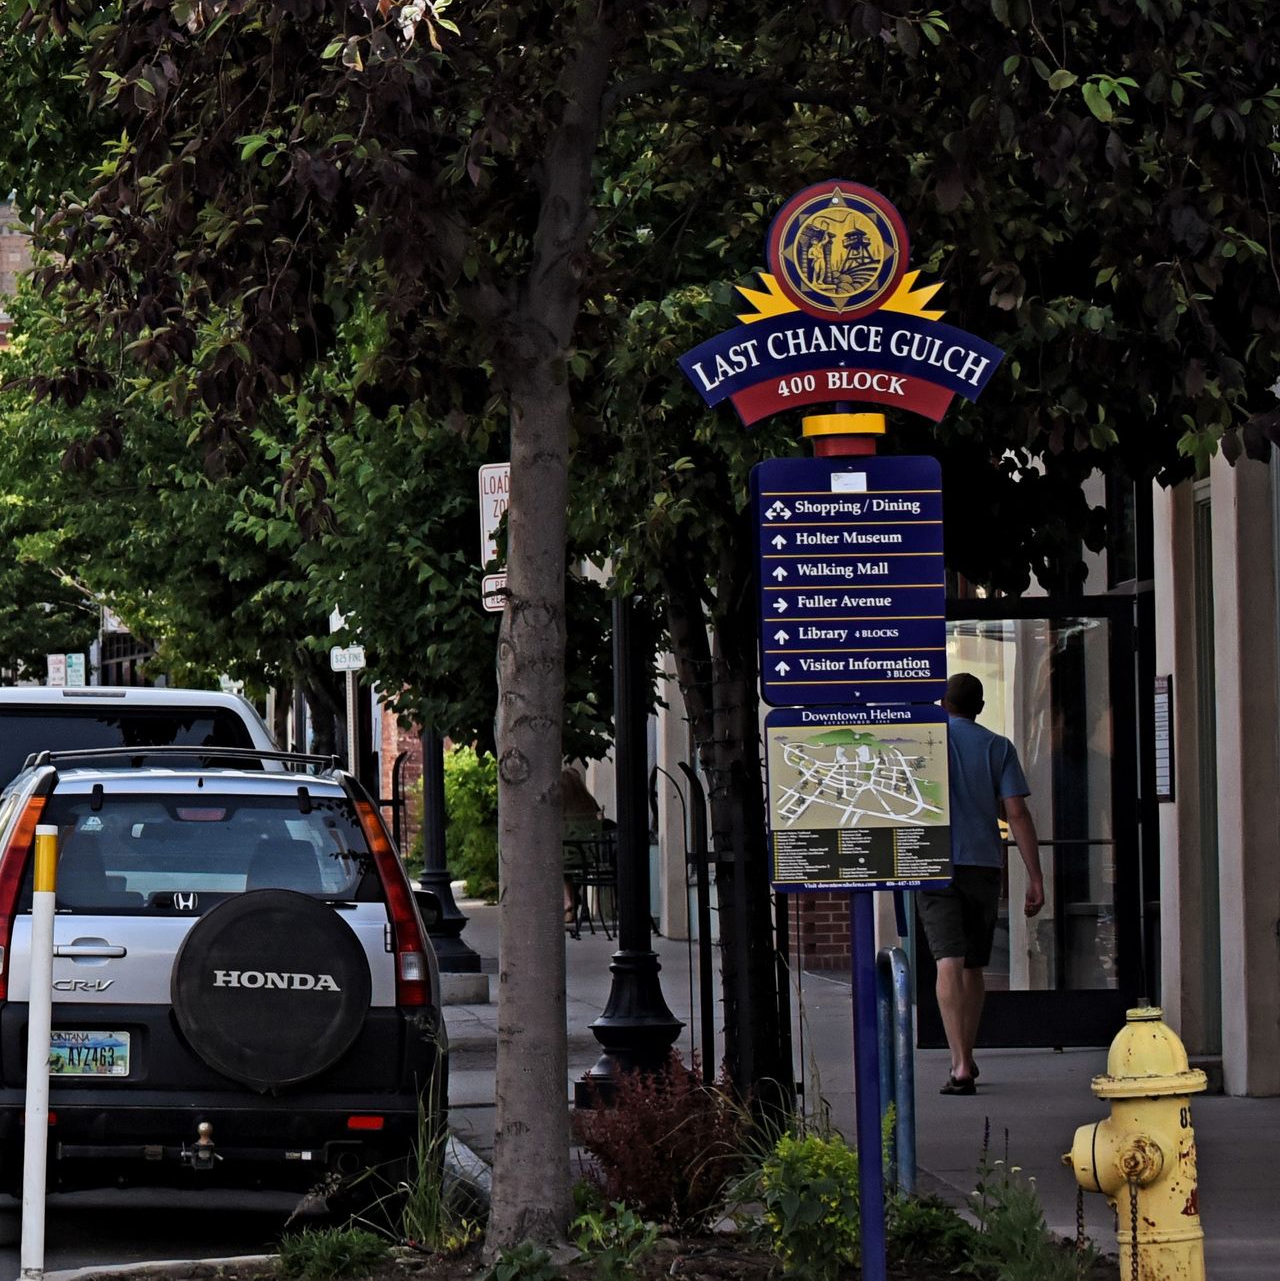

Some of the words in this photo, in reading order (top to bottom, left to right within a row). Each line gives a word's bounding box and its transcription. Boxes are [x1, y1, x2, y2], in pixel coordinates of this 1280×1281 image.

[692, 341, 760, 391] LAST
[766, 325, 884, 360] CHANCE
[890, 329, 990, 386] GULCH
[778, 375, 816, 397] 400
[826, 372, 908, 395] BLOCK
[795, 500, 861, 516] Shopping
[872, 499, 921, 514] Dining
[796, 532, 839, 545] Holter
[843, 532, 902, 544] Museum
[797, 563, 854, 579] Walking
[856, 562, 889, 574] Mall
[798, 595, 838, 608] Fuller
[841, 595, 892, 607] Avenue
[799, 627, 848, 642] Library
[855, 630, 860, 638] 4
[862, 629, 899, 638] BLOCKS
[348, 653, 362, 663] FINE
[800, 658, 847, 671] Visitor
[848, 657, 930, 670] Information
[893, 670, 931, 678] BLOCKS
[802, 710, 867, 722] Downtown
[870, 710, 912, 720] Helena
[52, 979, 115, 992] CR-V
[213, 970, 341, 991] HONDA
[68, 1047, 115, 1066] AYZ463
